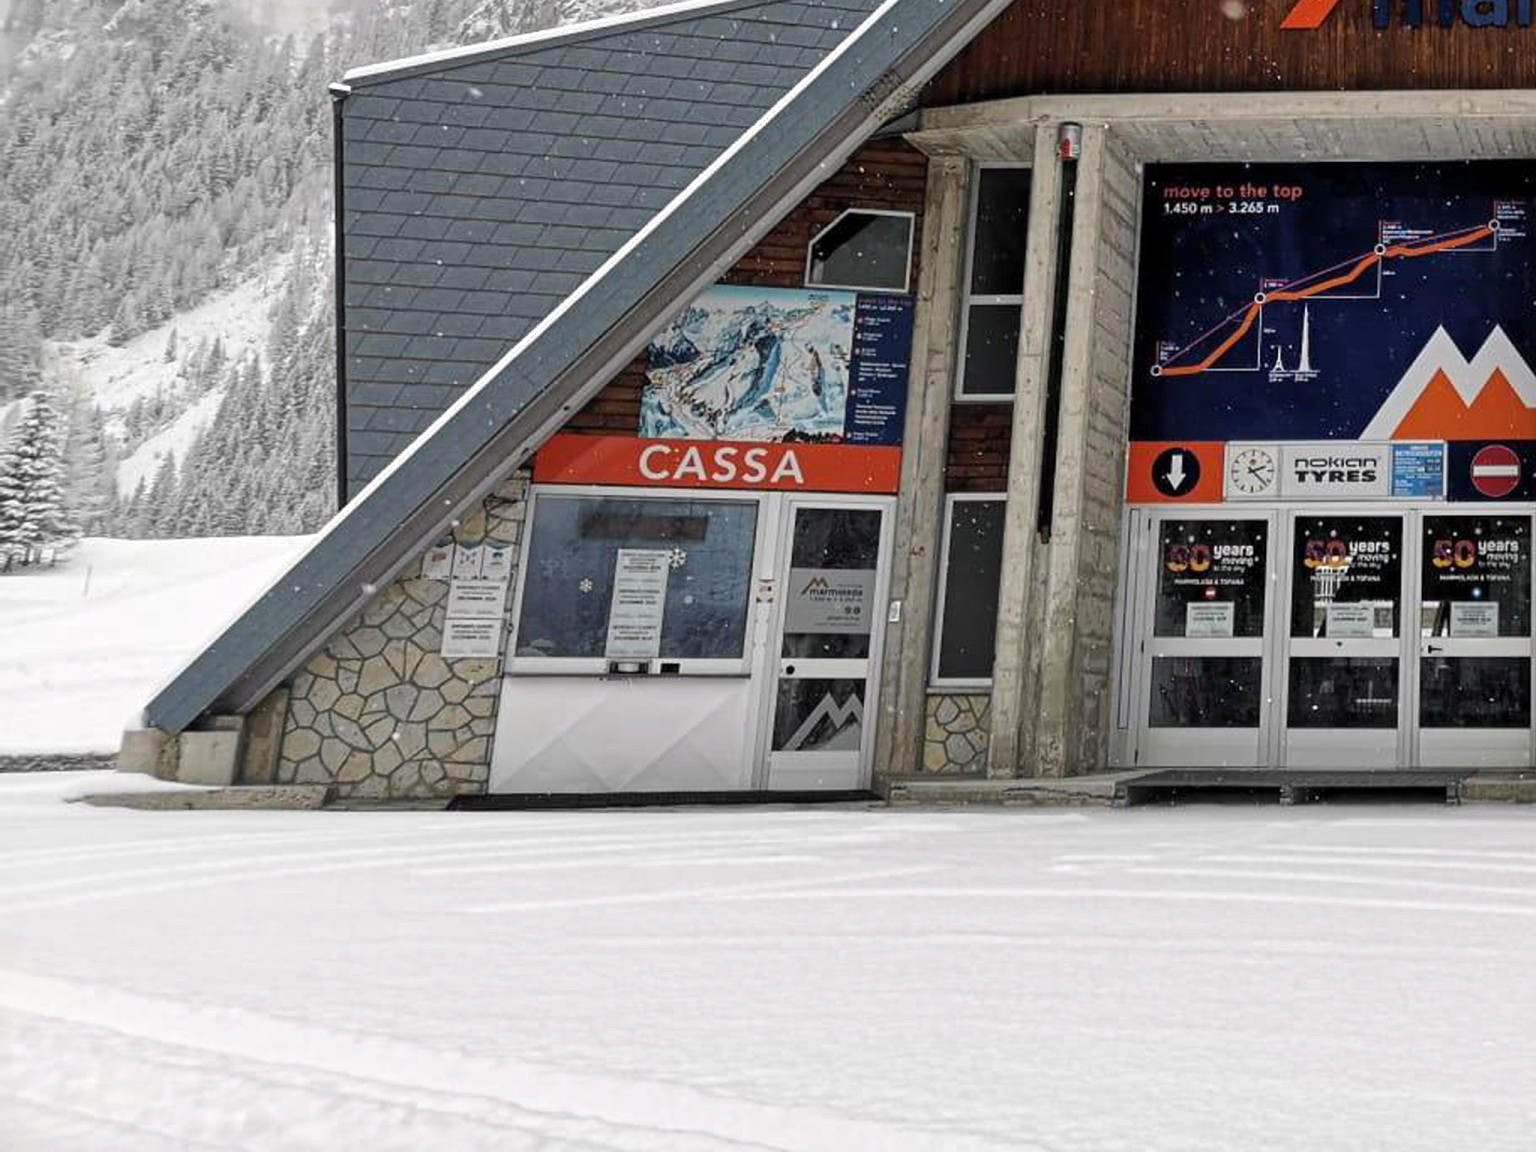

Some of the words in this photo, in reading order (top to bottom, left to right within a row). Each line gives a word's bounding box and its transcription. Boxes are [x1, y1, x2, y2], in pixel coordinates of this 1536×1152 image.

[1164, 187, 1210, 198] move
[1216, 186, 1234, 198] to
[1240, 182, 1267, 198] the
[1274, 185, 1302, 201] top
[1164, 202, 1197, 214] 1.450
[1200, 204, 1213, 214] m
[1229, 202, 1264, 214] 3.265
[1267, 204, 1279, 214] m
[639, 444, 804, 484] CASSA
[1294, 456, 1377, 468] nokian
[1294, 470, 1377, 483] TYRES
[1214, 545, 1254, 559] years
[1349, 541, 1390, 556] years
[1432, 539, 1475, 568] 50
[1478, 540, 1519, 556] years
[1357, 554, 1389, 564] moving
[1486, 553, 1519, 564] moving
